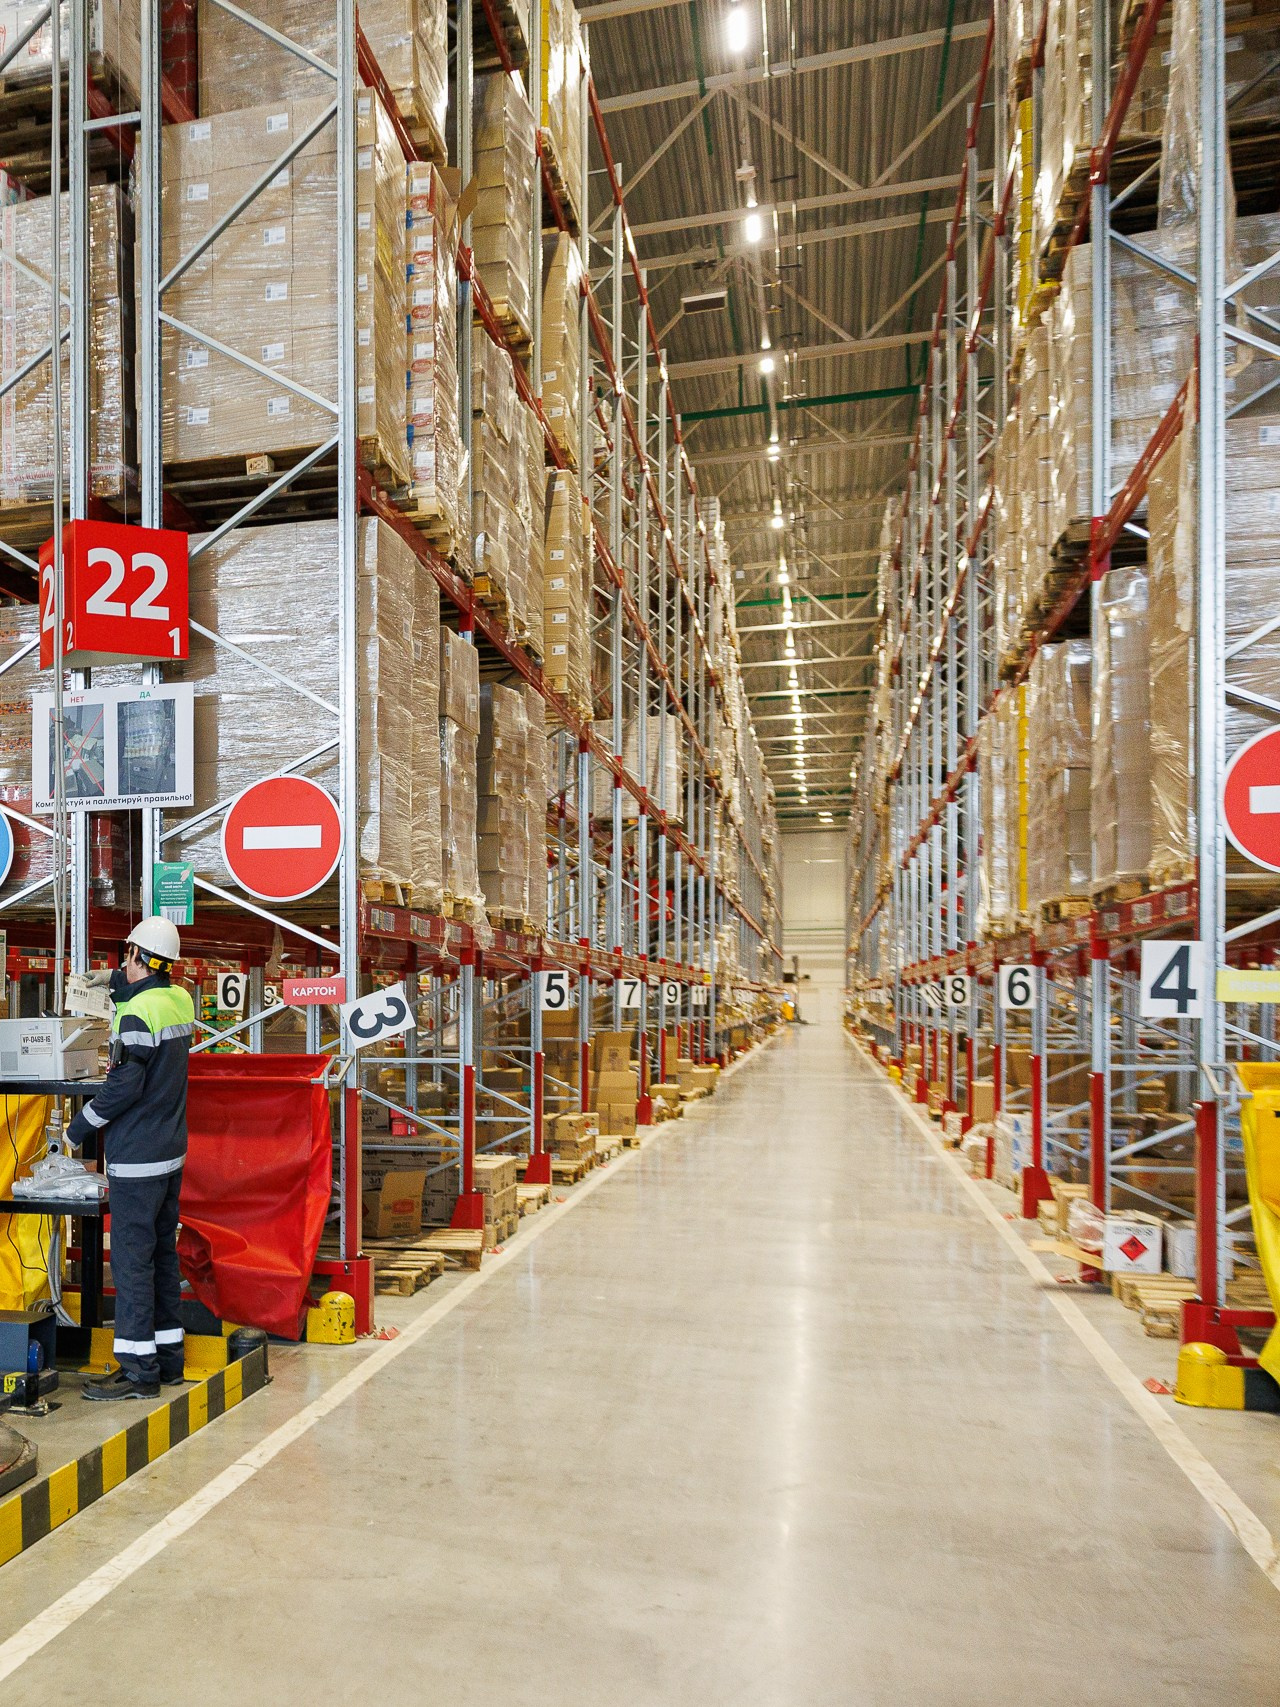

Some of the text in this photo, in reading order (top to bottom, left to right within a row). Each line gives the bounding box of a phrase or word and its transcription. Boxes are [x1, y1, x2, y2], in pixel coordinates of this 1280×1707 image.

[86, 547, 169, 621] 22
[66, 621, 74, 650] 2
[168, 627, 180, 656] 1
[139, 691, 151, 699] ДА
[93, 795, 142, 805] паллетируй
[144, 793, 192, 803] правильно!
[222, 975, 241, 1008] 6
[292, 986, 336, 997] КАРТОН
[545, 973, 565, 1008] 5
[623, 981, 638, 1005] 7
[667, 984, 678, 1003] 9
[951, 978, 966, 1004] 8
[1008, 967, 1031, 1006] 6
[1150, 945, 1197, 1014] 4
[349, 997, 407, 1039] 3
